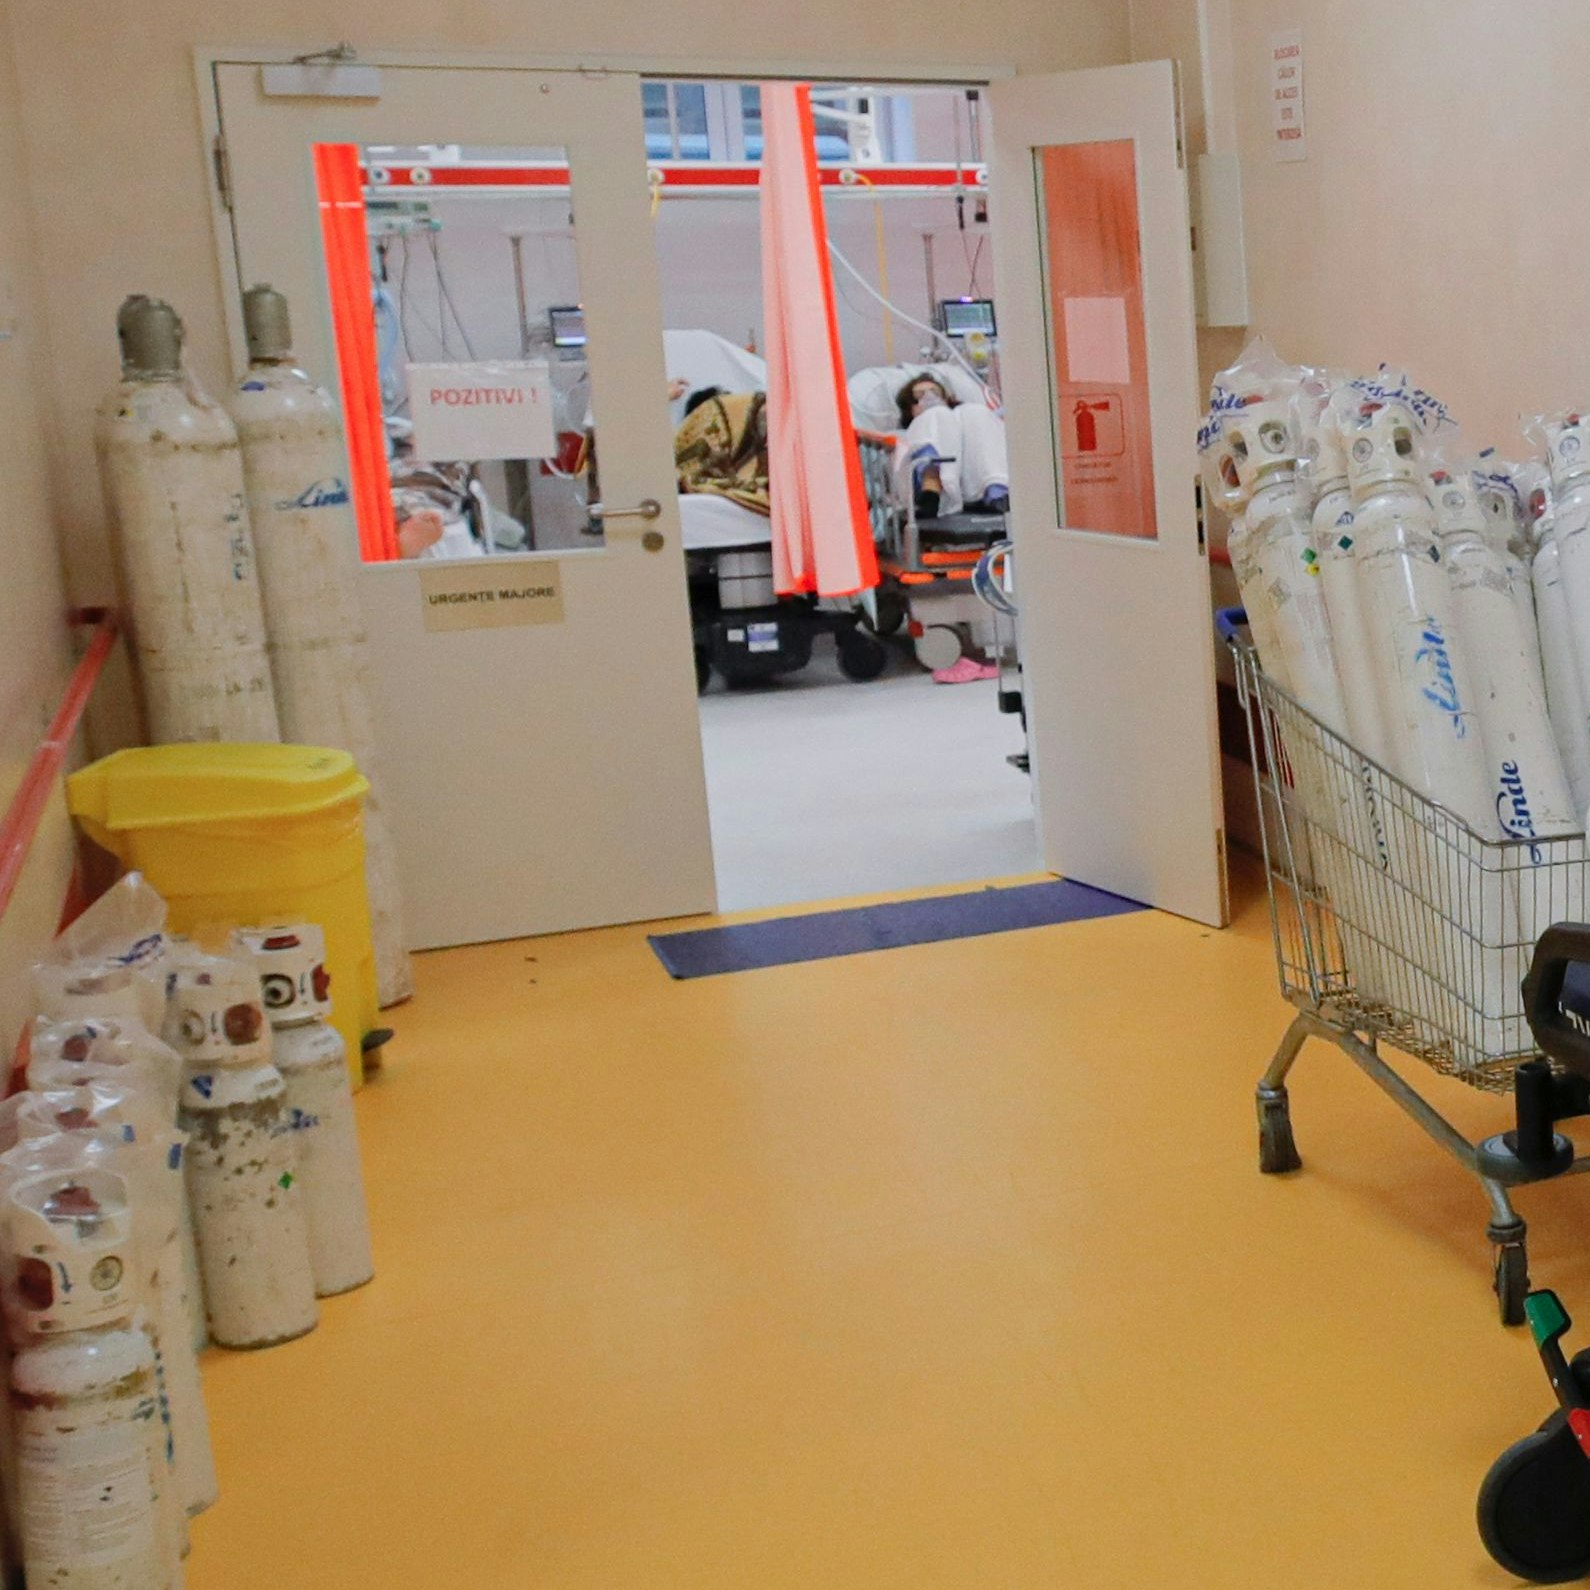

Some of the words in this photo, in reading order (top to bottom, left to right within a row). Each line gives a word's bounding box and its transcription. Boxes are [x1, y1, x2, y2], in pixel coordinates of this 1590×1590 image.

[429, 388, 524, 406] POZITIVI
[498, 586, 555, 601] MAJORE
[1496, 759, 1542, 866] Linde
